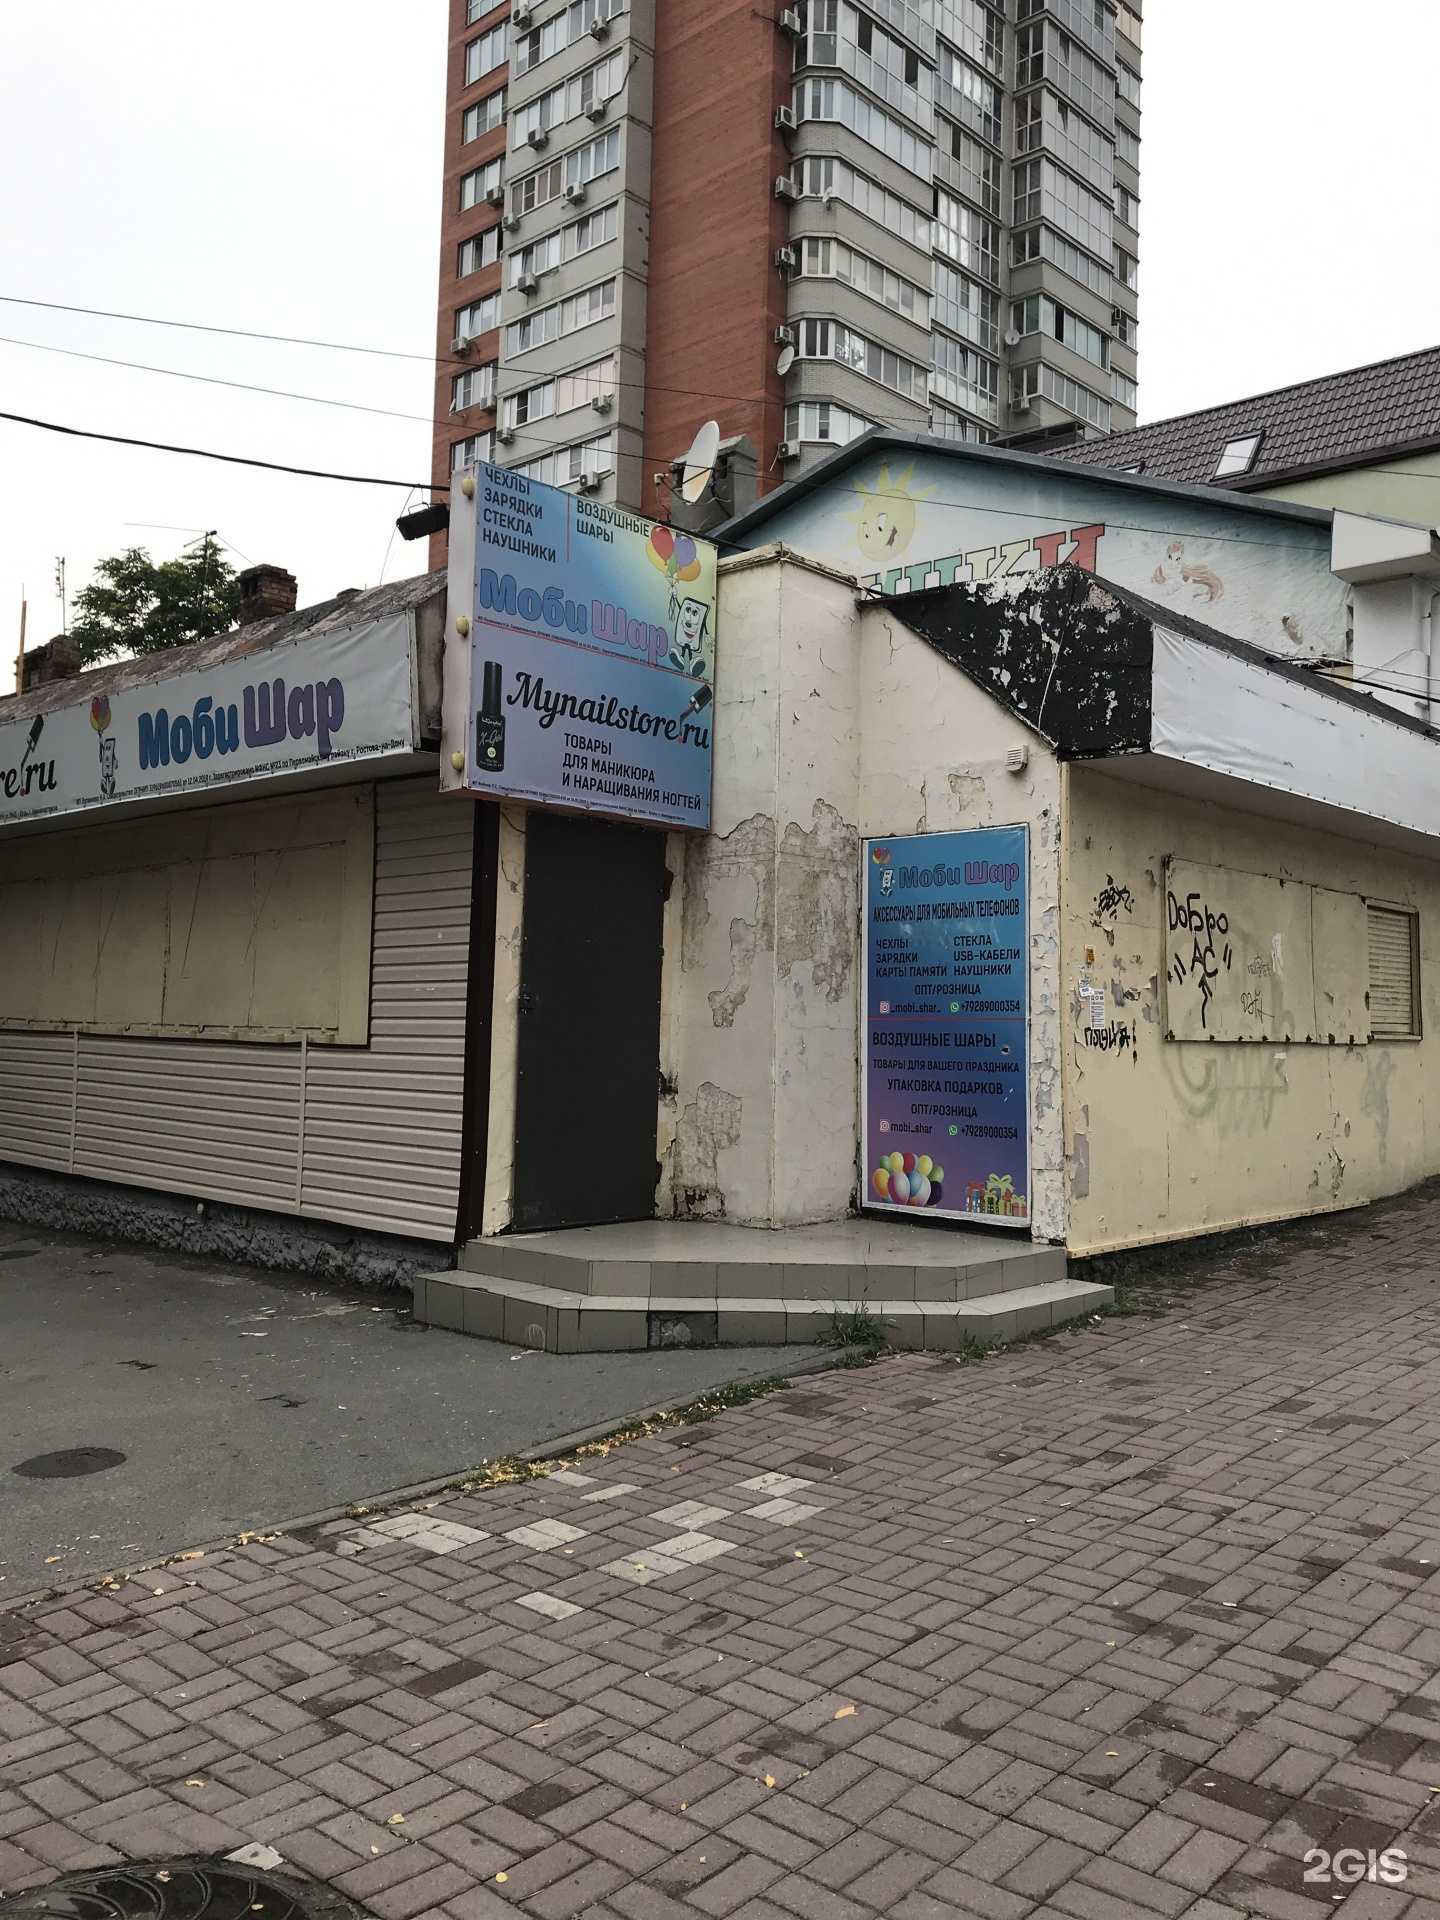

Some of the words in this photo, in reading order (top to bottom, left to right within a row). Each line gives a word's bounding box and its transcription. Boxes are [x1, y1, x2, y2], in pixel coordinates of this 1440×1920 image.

[485, 467, 531, 496] ЧЕХЛЫ
[484, 491, 543, 520] ЗАРЯДКИ
[483, 508, 533, 537] СТЕКЛА
[577, 500, 649, 538] ВОЗДУШНЫЕ
[577, 519, 614, 544] ШАРЫ
[482, 528, 556, 562] НАУШНИКИ
[564, 733, 612, 756] ТОВАРЫ
[562, 753, 588, 772] ДЛЯ
[591, 757, 655, 783] МАНИКЮРА
[562, 773, 571, 788] И
[573, 775, 660, 805] НАРАЩИВАНИЯ
[662, 790, 702, 811] НОГТЕЙ
[899, 864, 961, 888] Моби
[964, 860, 1019, 891] Шар
[873, 903, 916, 923] АКСЕССУАРЫ
[916, 904, 931, 921] ДЛЯ
[932, 901, 975, 920] МОБИЛЬНЫХ
[976, 898, 1020, 917] ТЕЛЕФОНОВ
[876, 938, 909, 949] ЧЕХЛЫ
[953, 935, 992, 947] СТЕКЛА
[876, 952, 918, 963] ЗАРЯДКИ
[953, 948, 1020, 961] USB-КАБЕЛИ
[876, 967, 907, 978] КАРТЫ
[909, 965, 947, 977] ПАМЯТИ
[953, 964, 1011, 976] НАУШНИКИ
[914, 984, 981, 996] ОПТ/РОЗНИЦА
[873, 1031, 950, 1047] ВОЗДУШНЫЕ
[954, 1033, 996, 1048] ШАРЫ
[873, 1059, 906, 1071] ТОВАРЫ
[908, 1059, 925, 1072] ДЛЯ
[927, 1060, 963, 1072] ВАШЕГО
[966, 1061, 1019, 1073] ПРАЗДНИКА
[887, 1079, 941, 1093] УПАКОВКА
[945, 1080, 1003, 1095] ПОДАРКОВ
[911, 1103, 978, 1118] ОПТ/РОЗНИЦА
